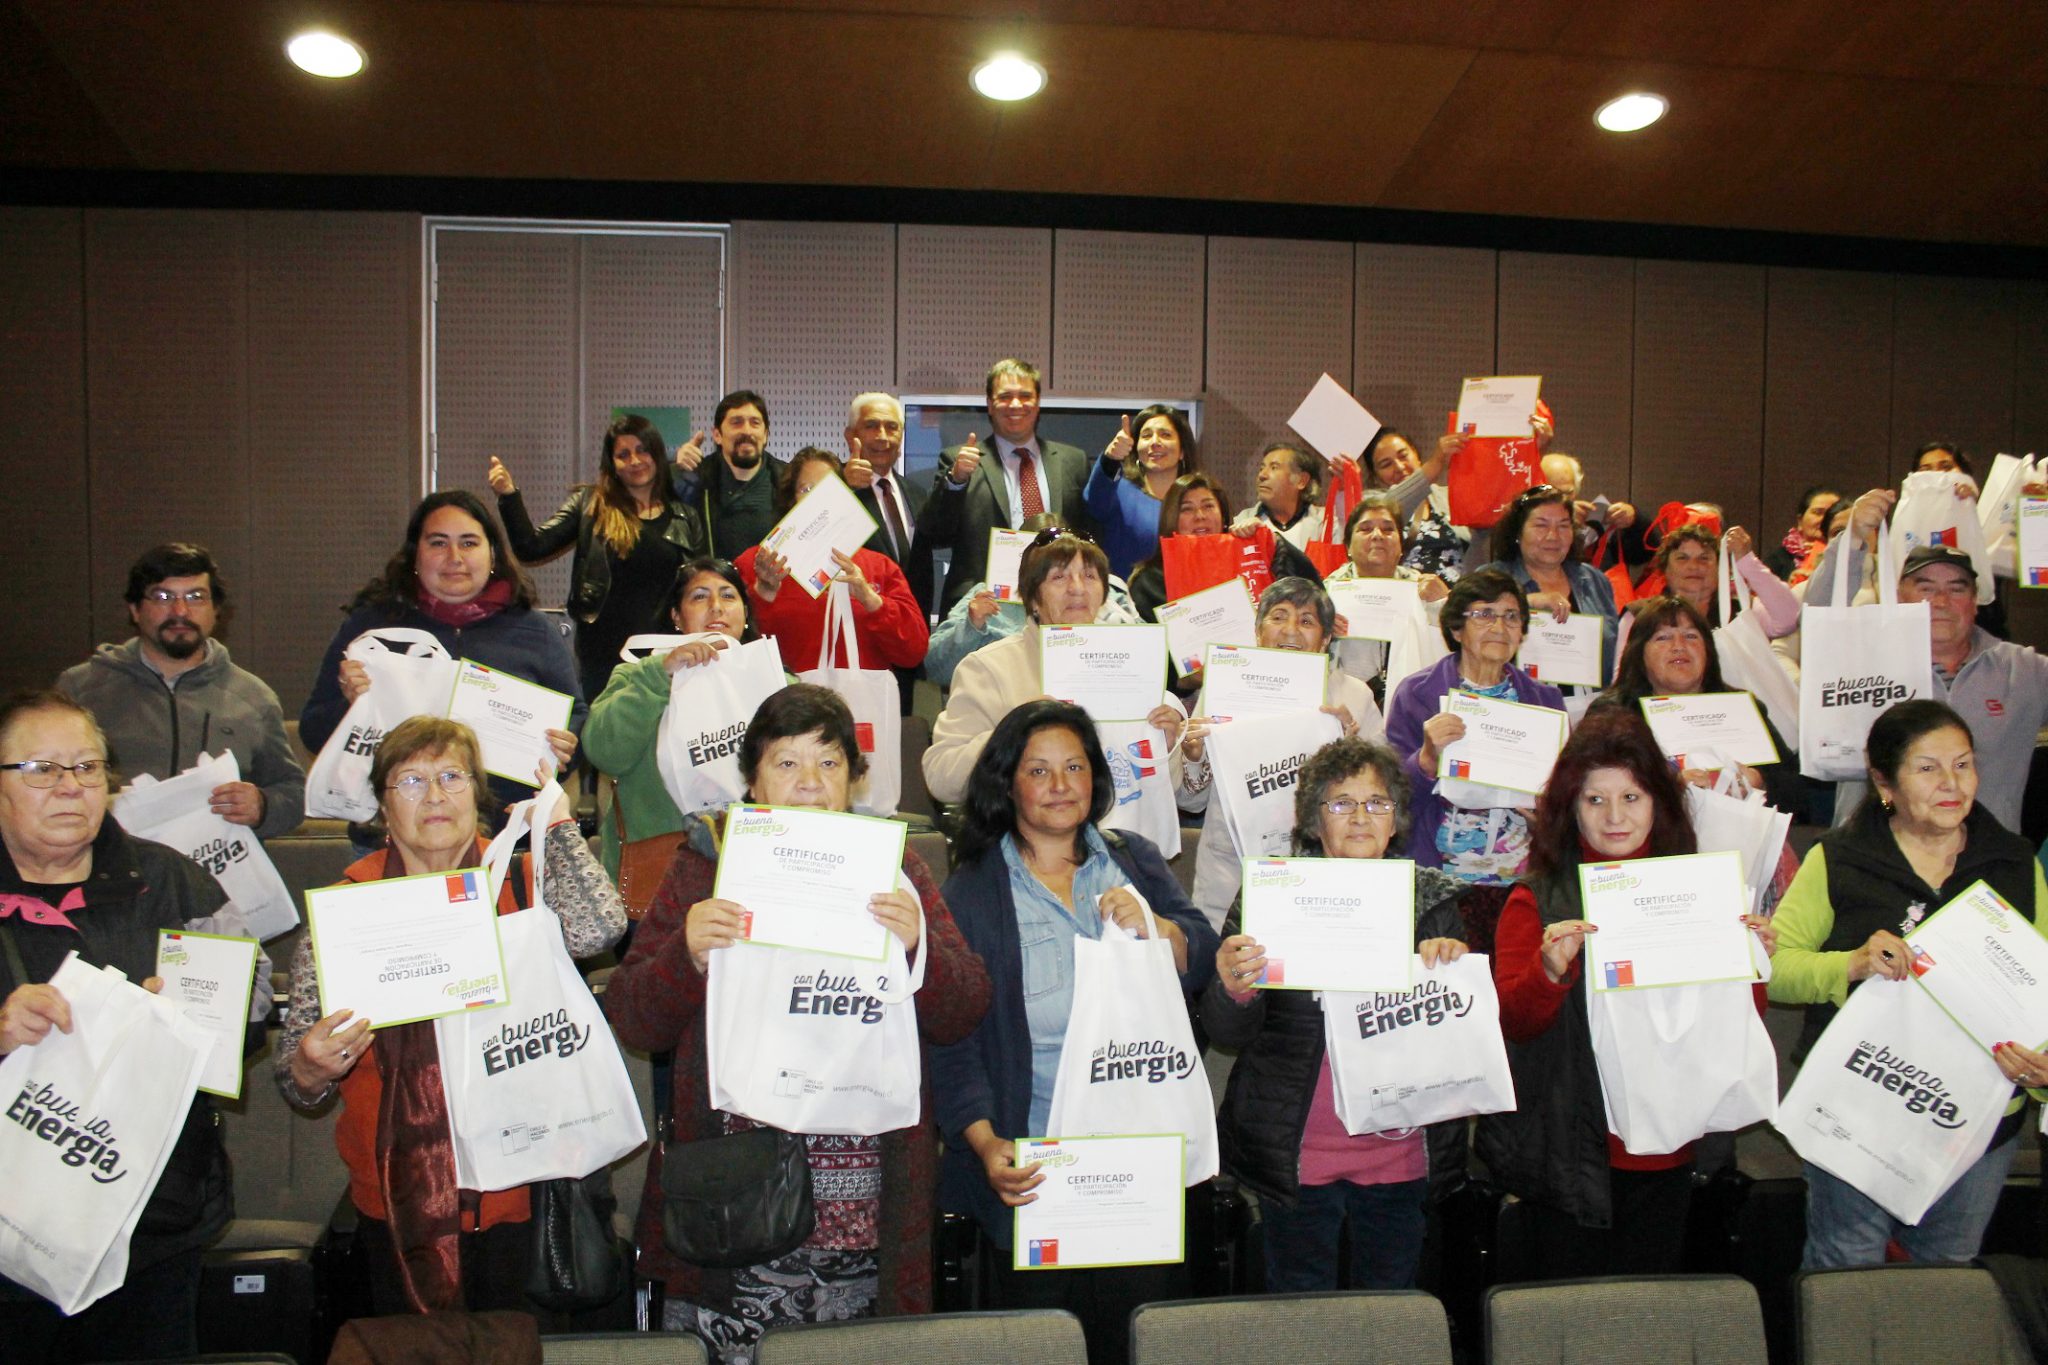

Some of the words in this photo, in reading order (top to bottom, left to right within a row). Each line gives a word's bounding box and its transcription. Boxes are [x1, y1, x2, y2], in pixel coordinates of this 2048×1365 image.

[1241, 673, 1290, 684] CERTIFICADO
[1837, 675, 1888, 691] buena
[1822, 680, 1908, 707] Energía
[488, 699, 533, 720] CERTIFICADO
[701, 721, 747, 746] buena
[1480, 723, 1527, 738] CERTIFICADO
[1247, 769, 1299, 800] Ener
[773, 847, 845, 864] CERTIFICADO
[1294, 896, 1361, 907] CERTIFICADO
[1634, 893, 1697, 906] CERTIFICADO
[1984, 935, 2037, 986] CERTIFICADO
[180, 977, 219, 991] CERTIFICADO
[379, 963, 451, 983] CERTIFICADO
[793, 975, 813, 984] con
[789, 986, 884, 1024] Energ
[1356, 1000, 1371, 1013] con
[1374, 980, 1441, 1012] buena
[1357, 985, 1464, 1039] Energía
[482, 1036, 498, 1050] con
[502, 1008, 569, 1044] buena
[1108, 1039, 1168, 1059] buena
[1090, 1046, 1188, 1084] Energía
[1859, 1040, 1877, 1053] con
[1875, 1046, 1945, 1093] buena
[1844, 1048, 1960, 1122] Energía
[6, 1089, 122, 1175] Energía
[1068, 1173, 1134, 1185] CERTIFICADO
